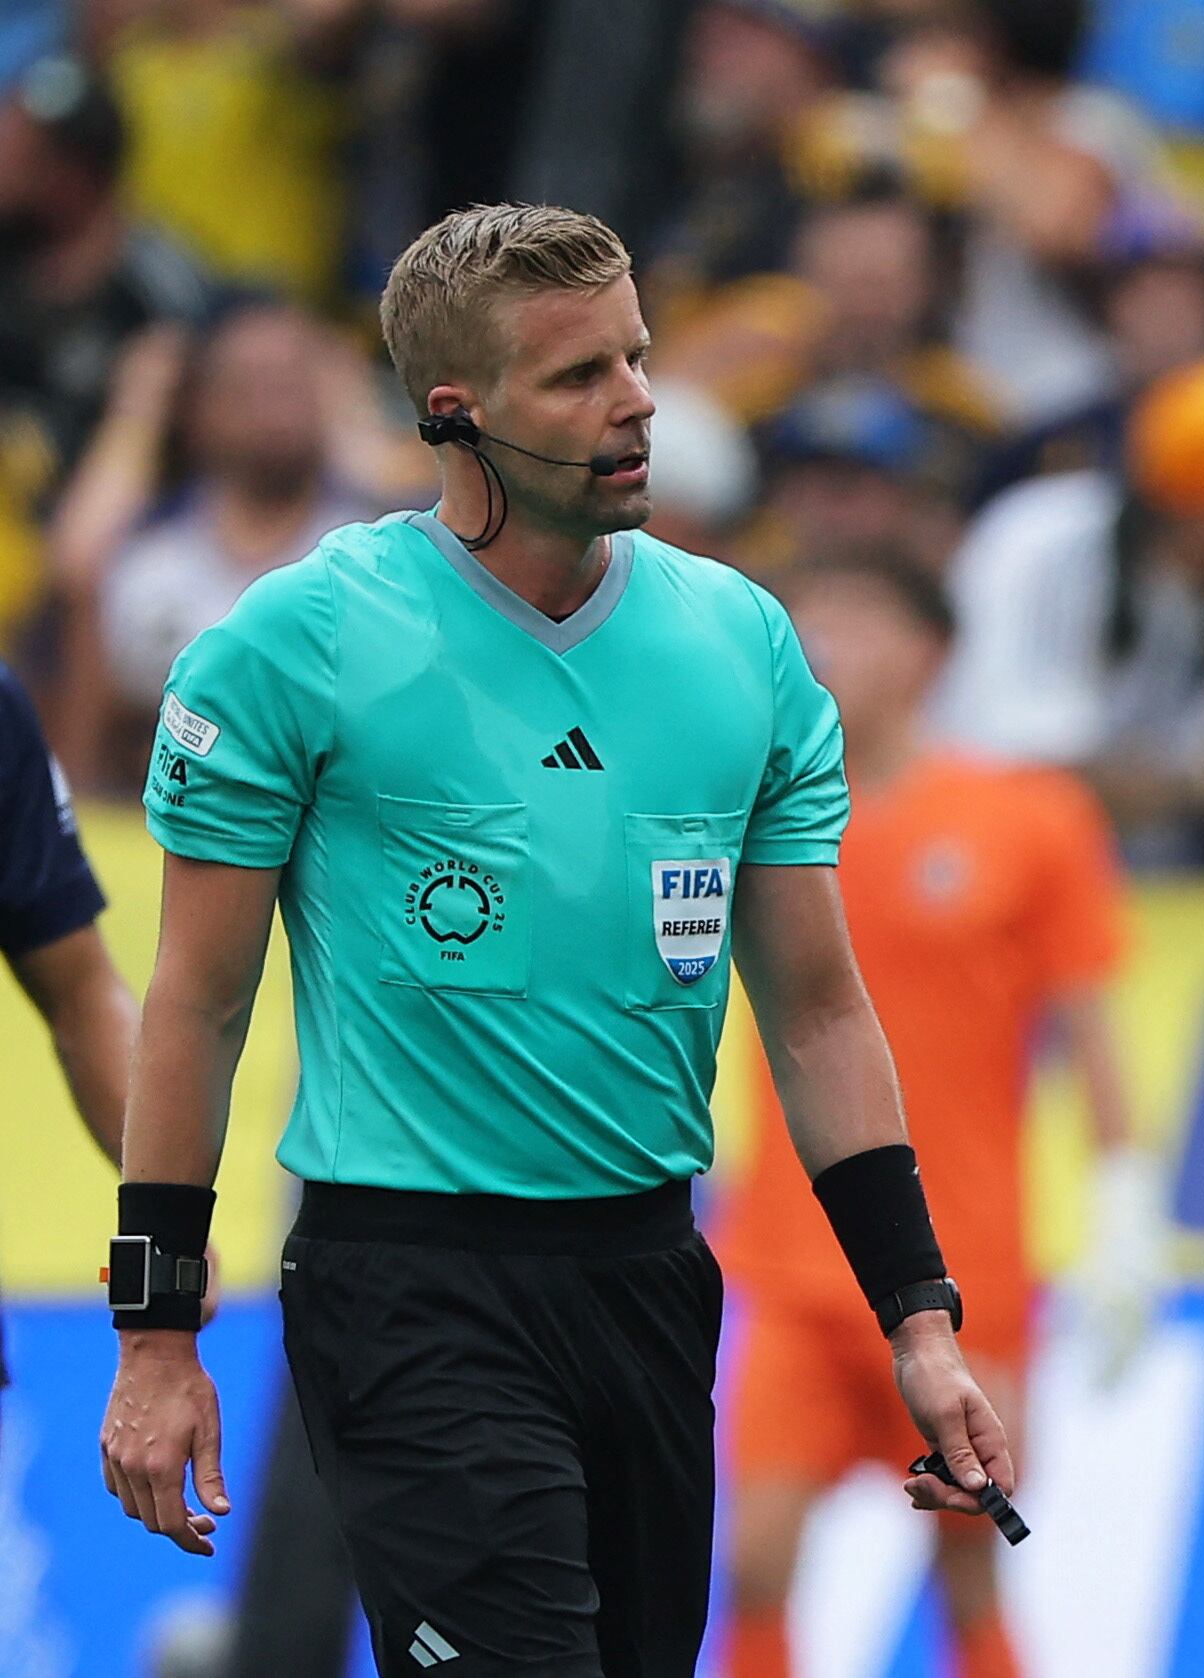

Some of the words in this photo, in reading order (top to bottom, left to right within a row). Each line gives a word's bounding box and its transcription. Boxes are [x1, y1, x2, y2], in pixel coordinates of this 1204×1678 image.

[420, 860, 478, 880] WORLD
[483, 875, 505, 904] CUP
[662, 868, 724, 899] FIFA
[405, 882, 420, 925] CLUB
[492, 913, 505, 933] 25
[662, 918, 721, 937] REFEREE
[440, 951, 465, 961] FIFA
[678, 961, 705, 976] 2025
